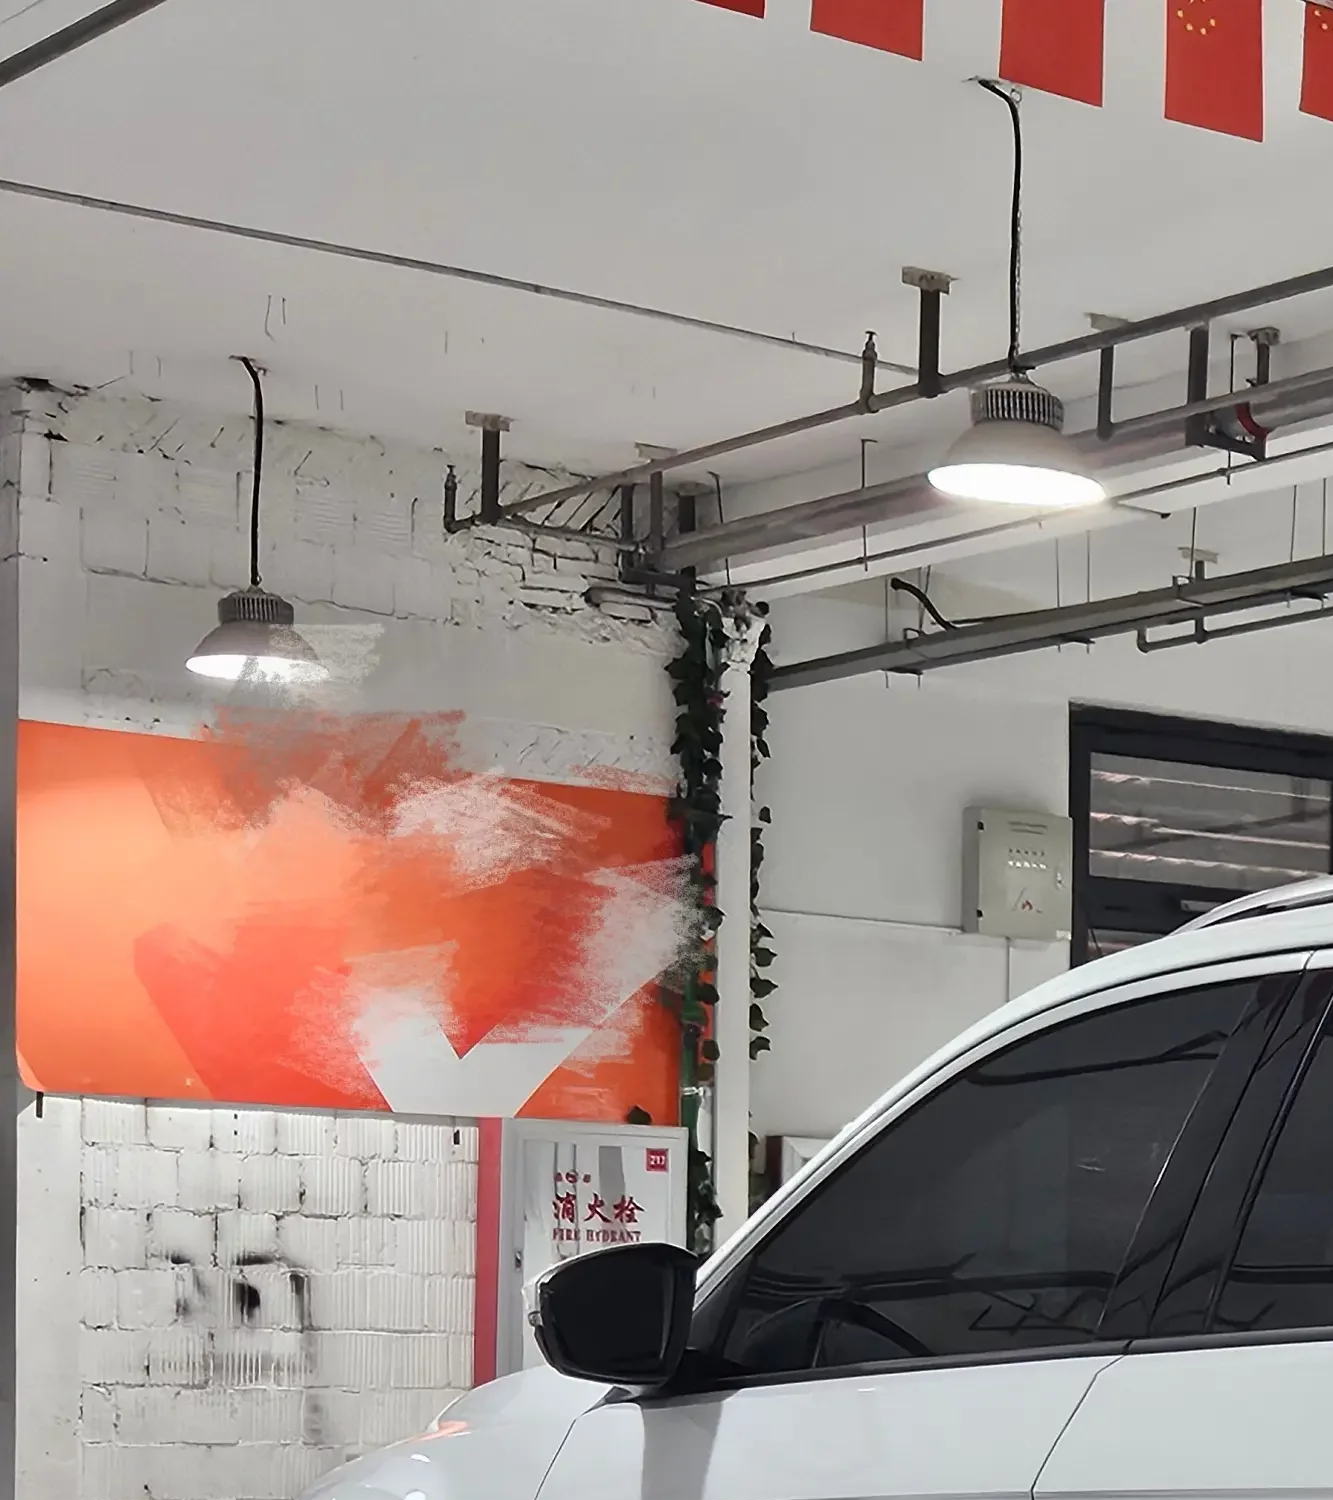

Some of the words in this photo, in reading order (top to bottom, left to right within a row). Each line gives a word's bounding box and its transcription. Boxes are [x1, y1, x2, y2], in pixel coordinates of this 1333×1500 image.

[552, 1191, 645, 1223] 消火栓
[552, 1227, 581, 1241] FIRE
[586, 1228, 642, 1243] HYDRANT
